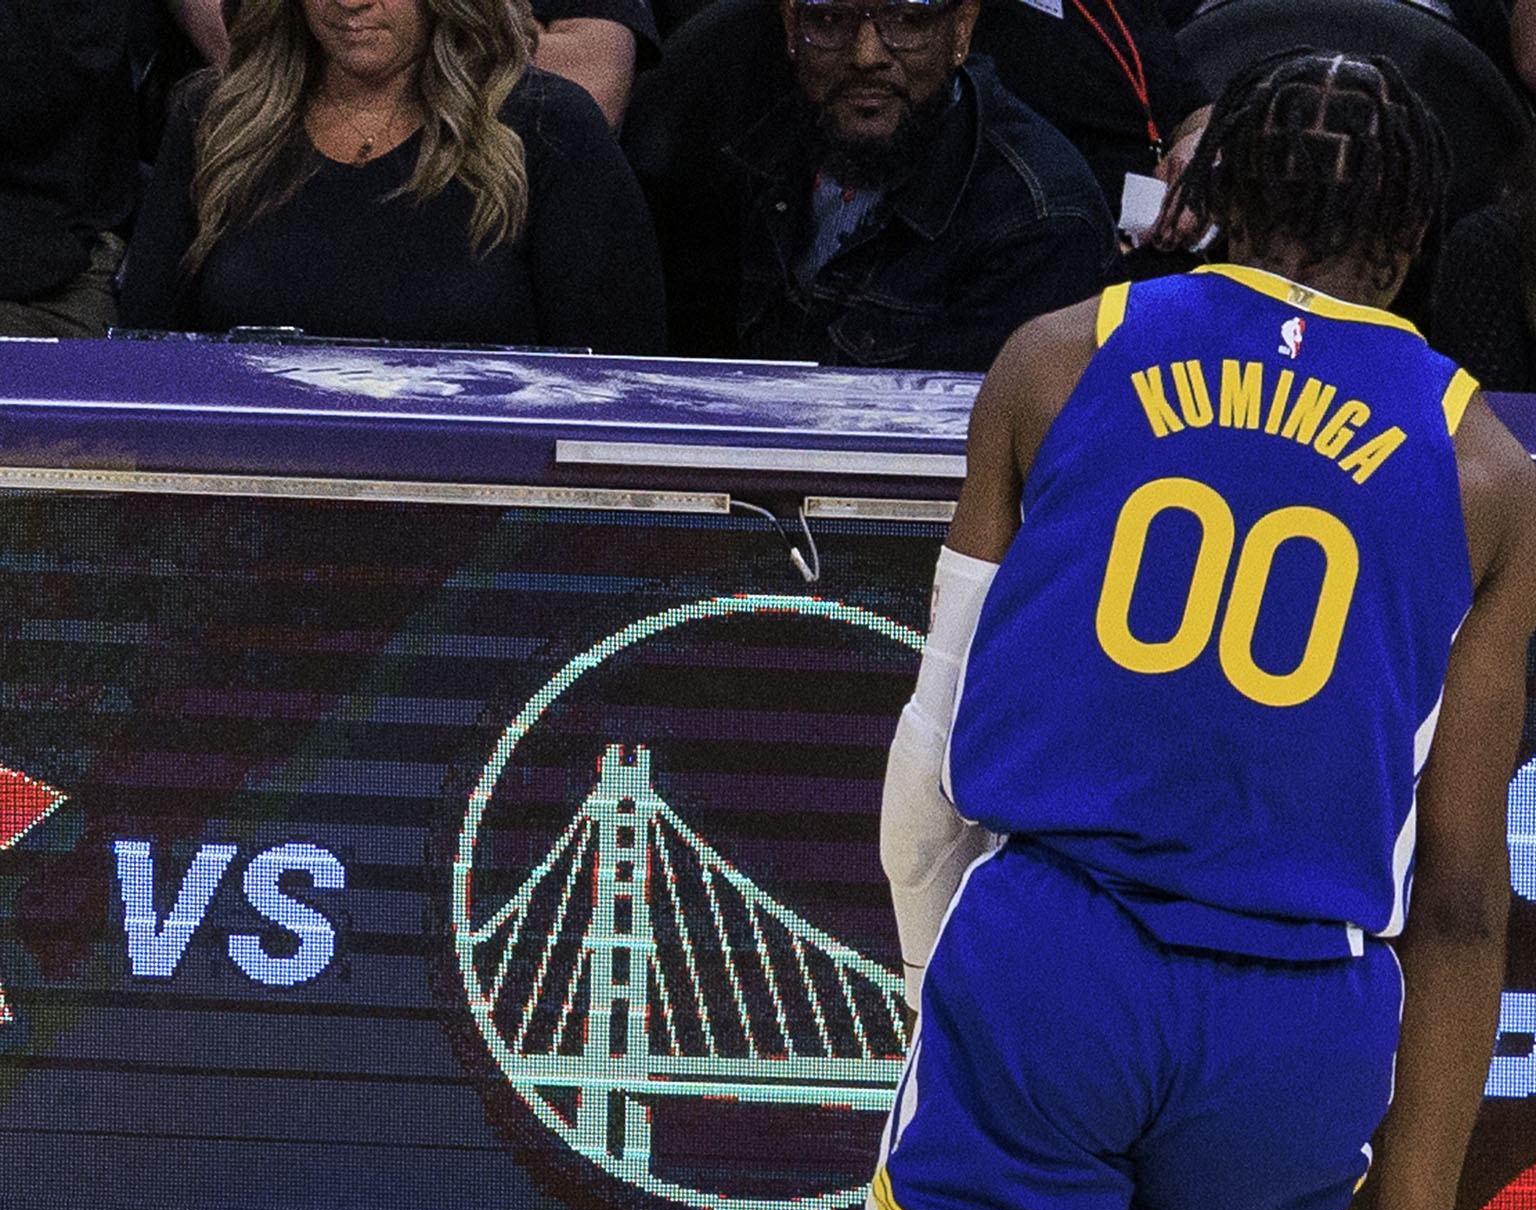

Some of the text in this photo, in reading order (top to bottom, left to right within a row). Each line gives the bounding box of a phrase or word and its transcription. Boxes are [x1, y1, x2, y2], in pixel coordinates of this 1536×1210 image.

[1131, 359, 1407, 485] KUMINGA
[1095, 477, 1359, 707] 00
[114, 840, 345, 986] VS
